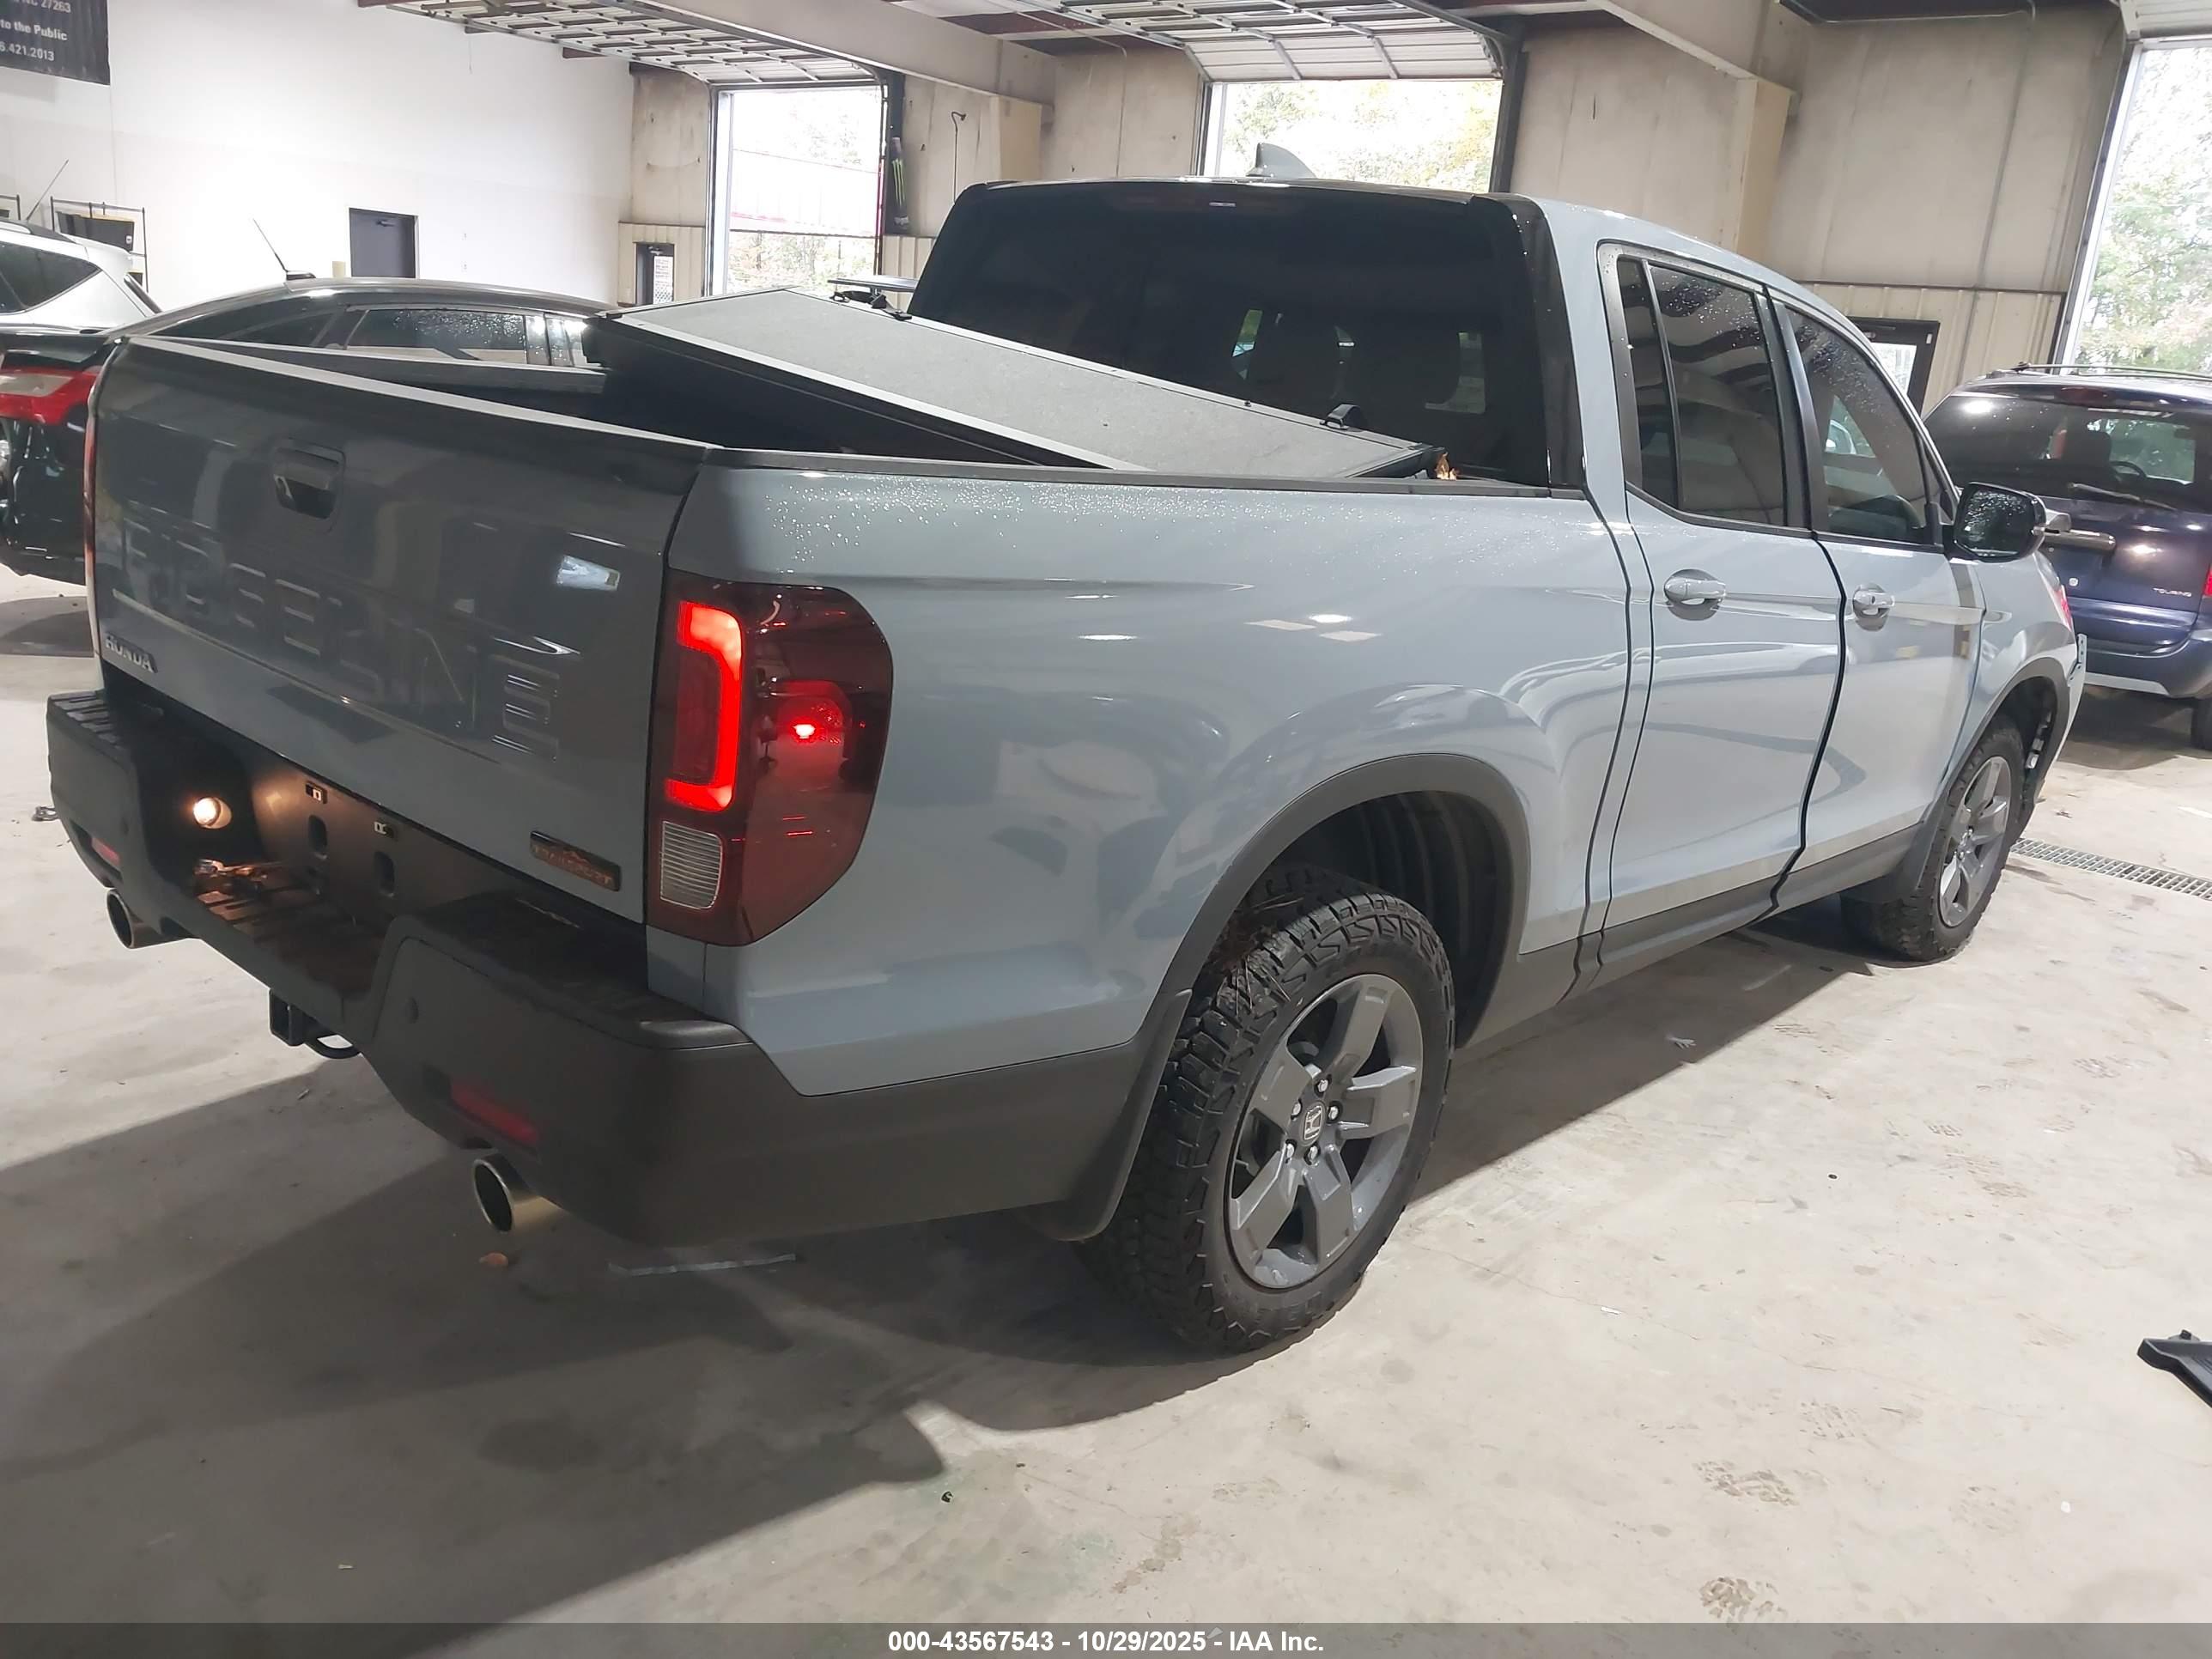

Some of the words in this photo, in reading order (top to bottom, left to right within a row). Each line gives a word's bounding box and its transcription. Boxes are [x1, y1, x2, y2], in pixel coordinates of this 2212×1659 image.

[0, 19, 11, 29] to
[14, 21, 31, 33] the
[34, 25, 68, 41] Public
[105, 635, 155, 673] HONDA
